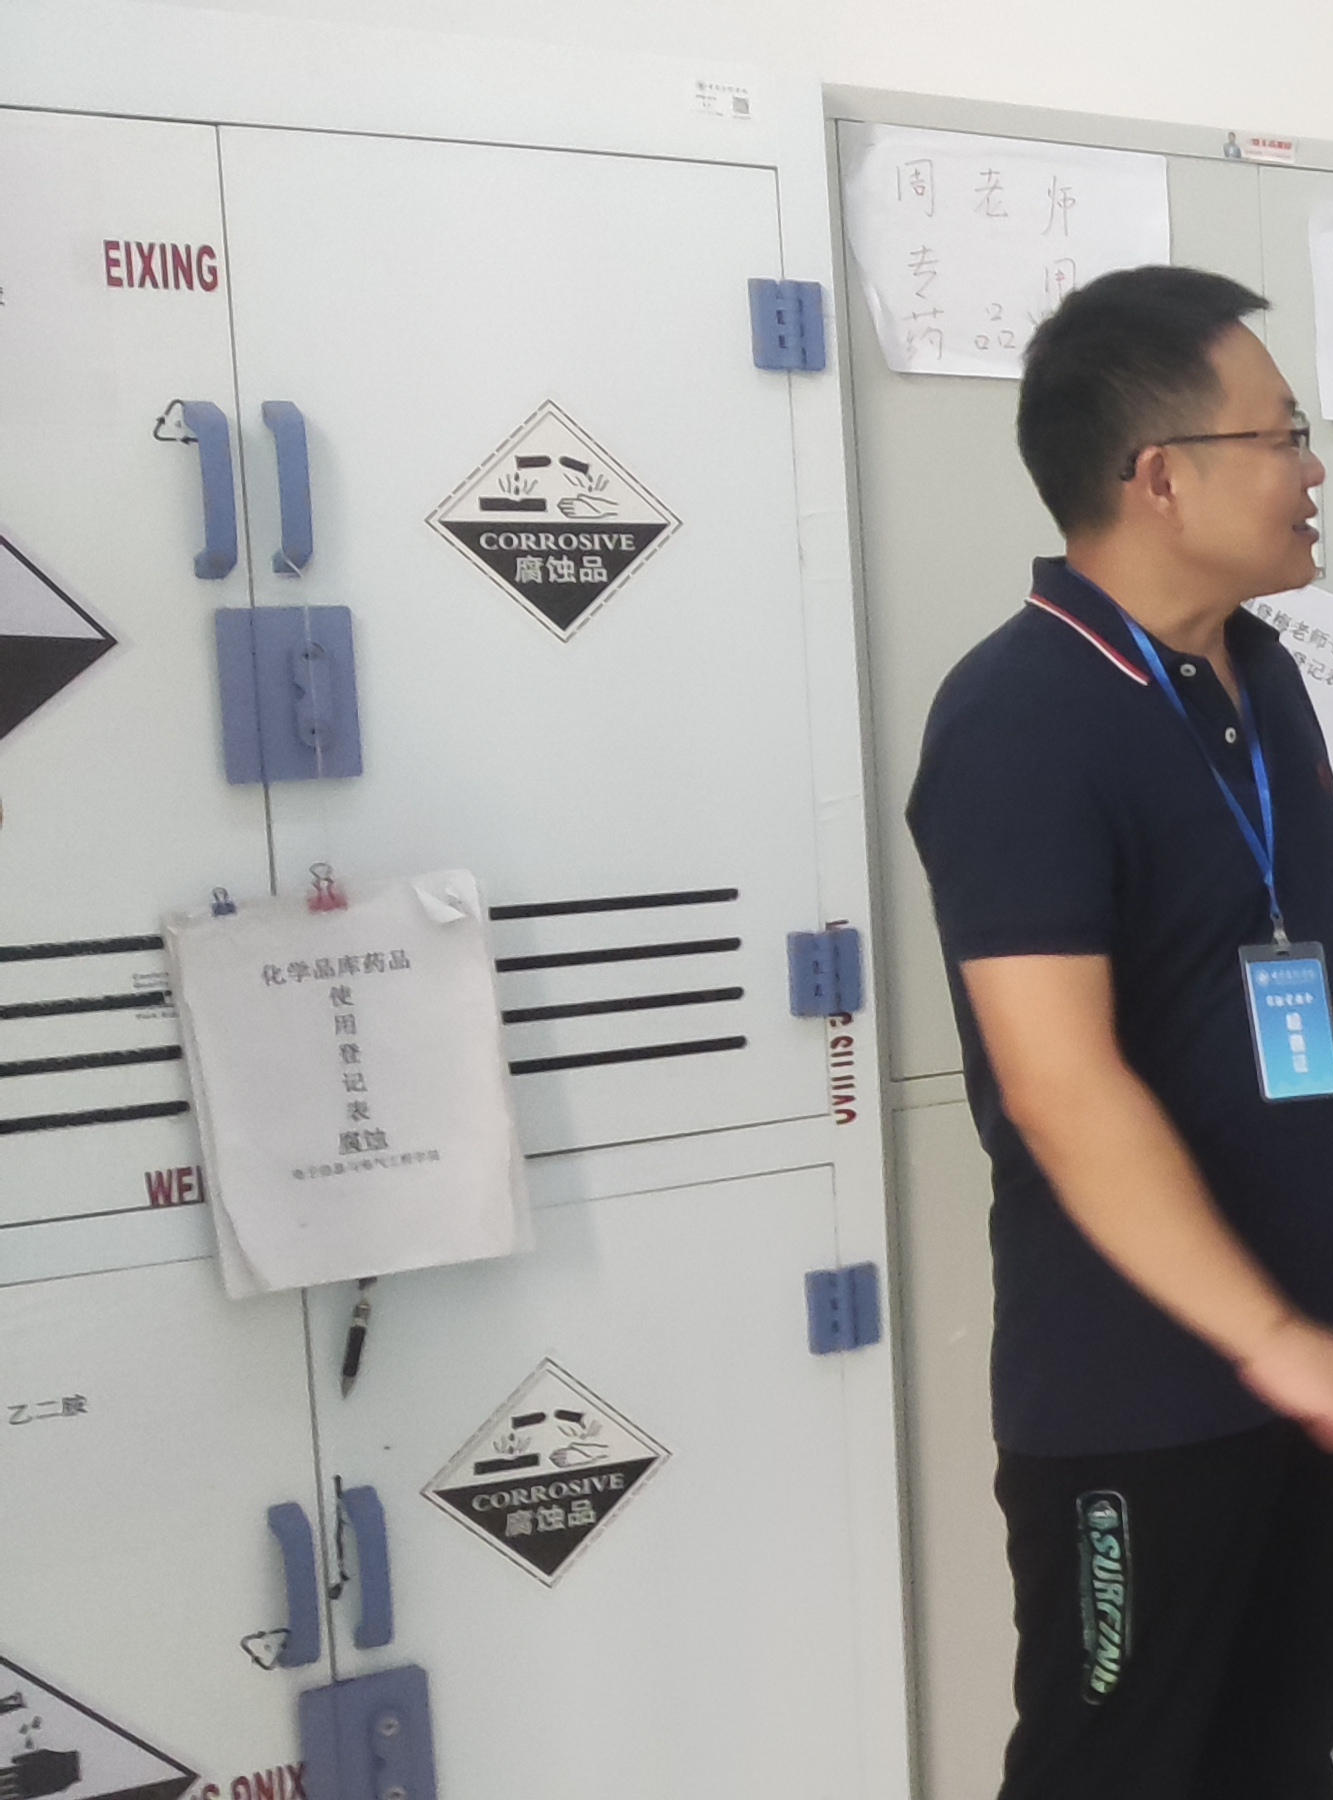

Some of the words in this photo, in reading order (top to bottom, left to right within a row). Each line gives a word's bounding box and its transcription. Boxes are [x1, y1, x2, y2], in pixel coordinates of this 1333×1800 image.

[103, 239, 218, 292] EIXING
[479, 531, 636, 551] CORROSIVE
[514, 554, 608, 584] 腐蚀品
[261, 949, 411, 987] 化学品库药品
[329, 984, 371, 1122] 使用登记表
[471, 1473, 625, 1512] CORROSIVE
[505, 1499, 597, 1537] 腐蚀品
